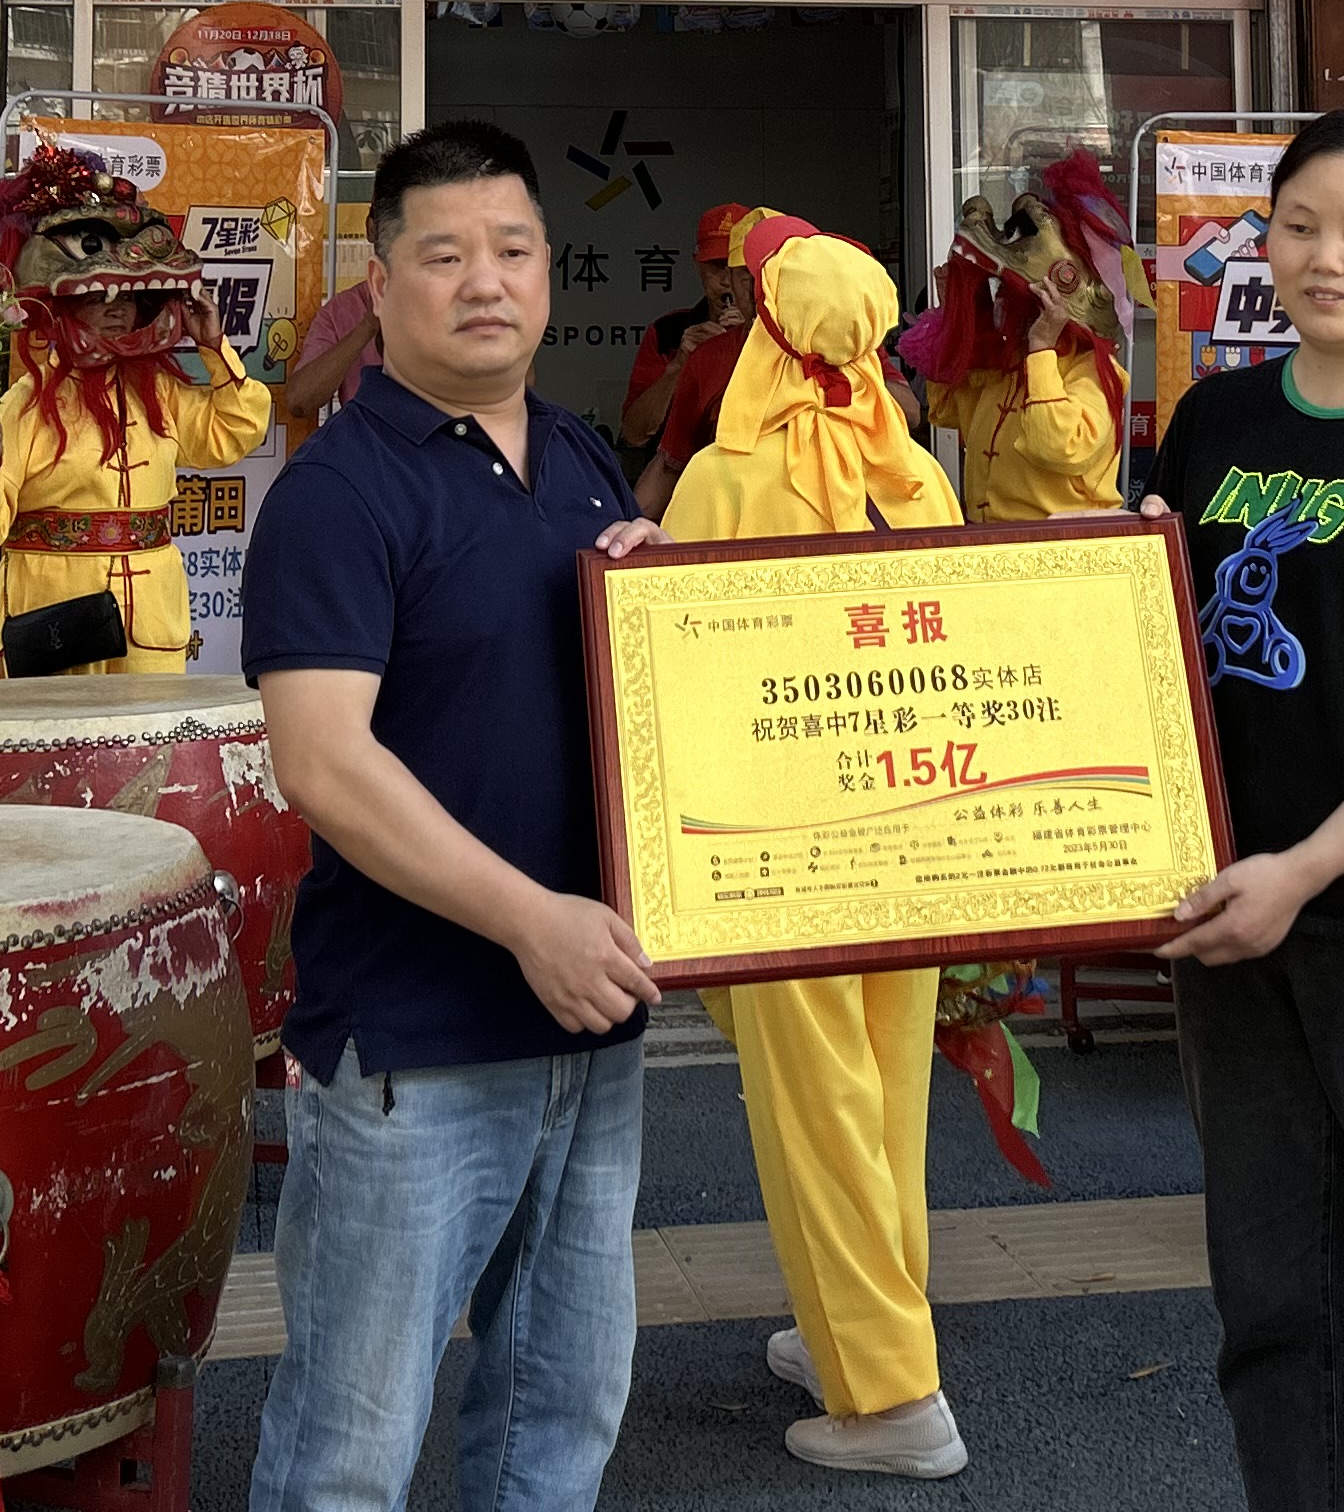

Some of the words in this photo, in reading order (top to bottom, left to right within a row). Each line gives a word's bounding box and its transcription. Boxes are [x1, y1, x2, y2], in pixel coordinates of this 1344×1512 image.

[164, 66, 324, 115] 竞猜世界杯
[106, 153, 162, 178] 育彩票
[200, 217, 260, 252] 7星彩
[556, 243, 680, 293] 体育
[202, 277, 260, 336] 报
[1226, 276, 1299, 334] 中
[171, 475, 246, 536] 莆田
[707, 613, 794, 634] 中国体育彩票
[844, 600, 948, 649] 喜报
[761, 663, 1043, 705] 3503060068实体店
[752, 696, 1063, 742] 祝贺喜中7星彩一等奖30注
[836, 749, 873, 770] 合计
[837, 772, 876, 792] 奖金
[876, 740, 988, 789] 1.5亿
[954, 802, 1024, 821] 公益体彩
